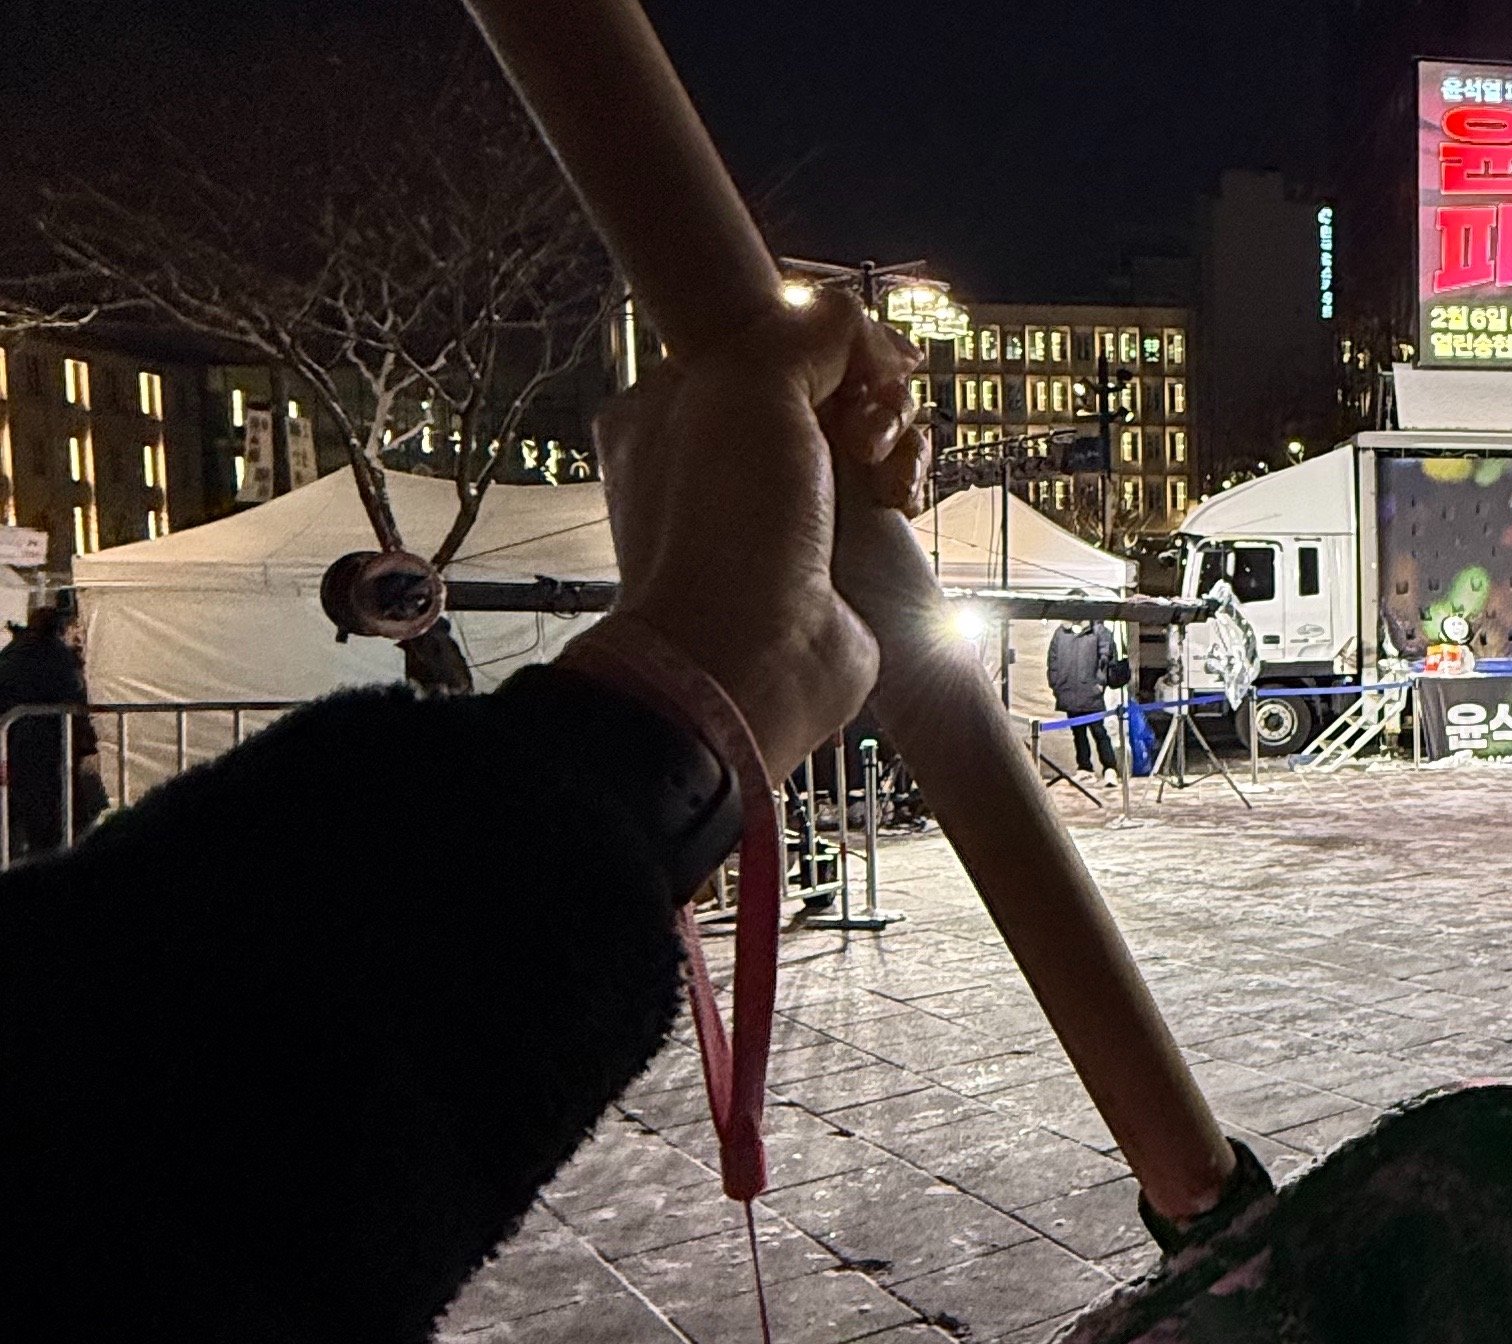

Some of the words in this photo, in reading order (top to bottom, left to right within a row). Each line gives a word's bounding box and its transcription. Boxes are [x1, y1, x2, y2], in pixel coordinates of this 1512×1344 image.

[1441, 76, 1502, 103] 윤석열
[1430, 306, 1469, 331] 2월
[1470, 306, 1508, 332] 6일
